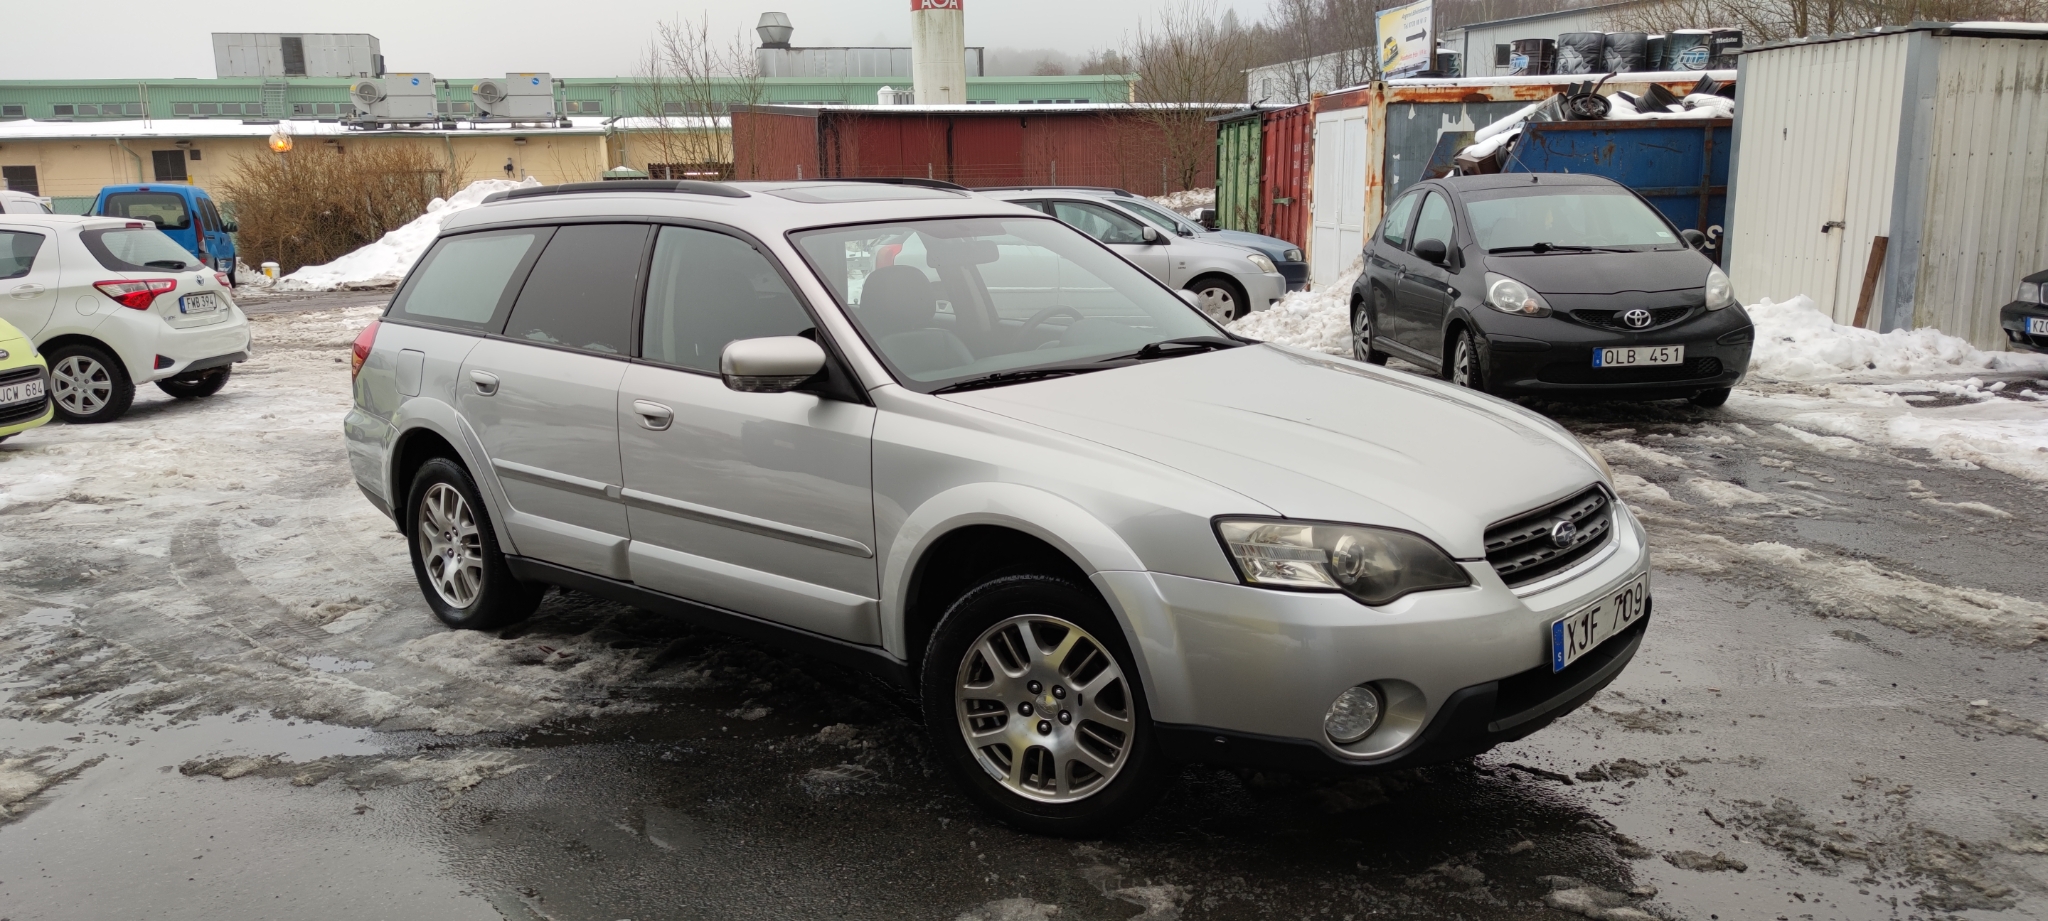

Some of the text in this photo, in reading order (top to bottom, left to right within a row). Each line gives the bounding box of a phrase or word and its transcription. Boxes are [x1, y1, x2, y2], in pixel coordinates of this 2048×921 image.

[186, 294, 214, 309] FWB 394
[1604, 347, 1679, 365] OLB 451
[0, 381, 42, 403] JCW 684
[1567, 582, 1643, 660] XJF 709
